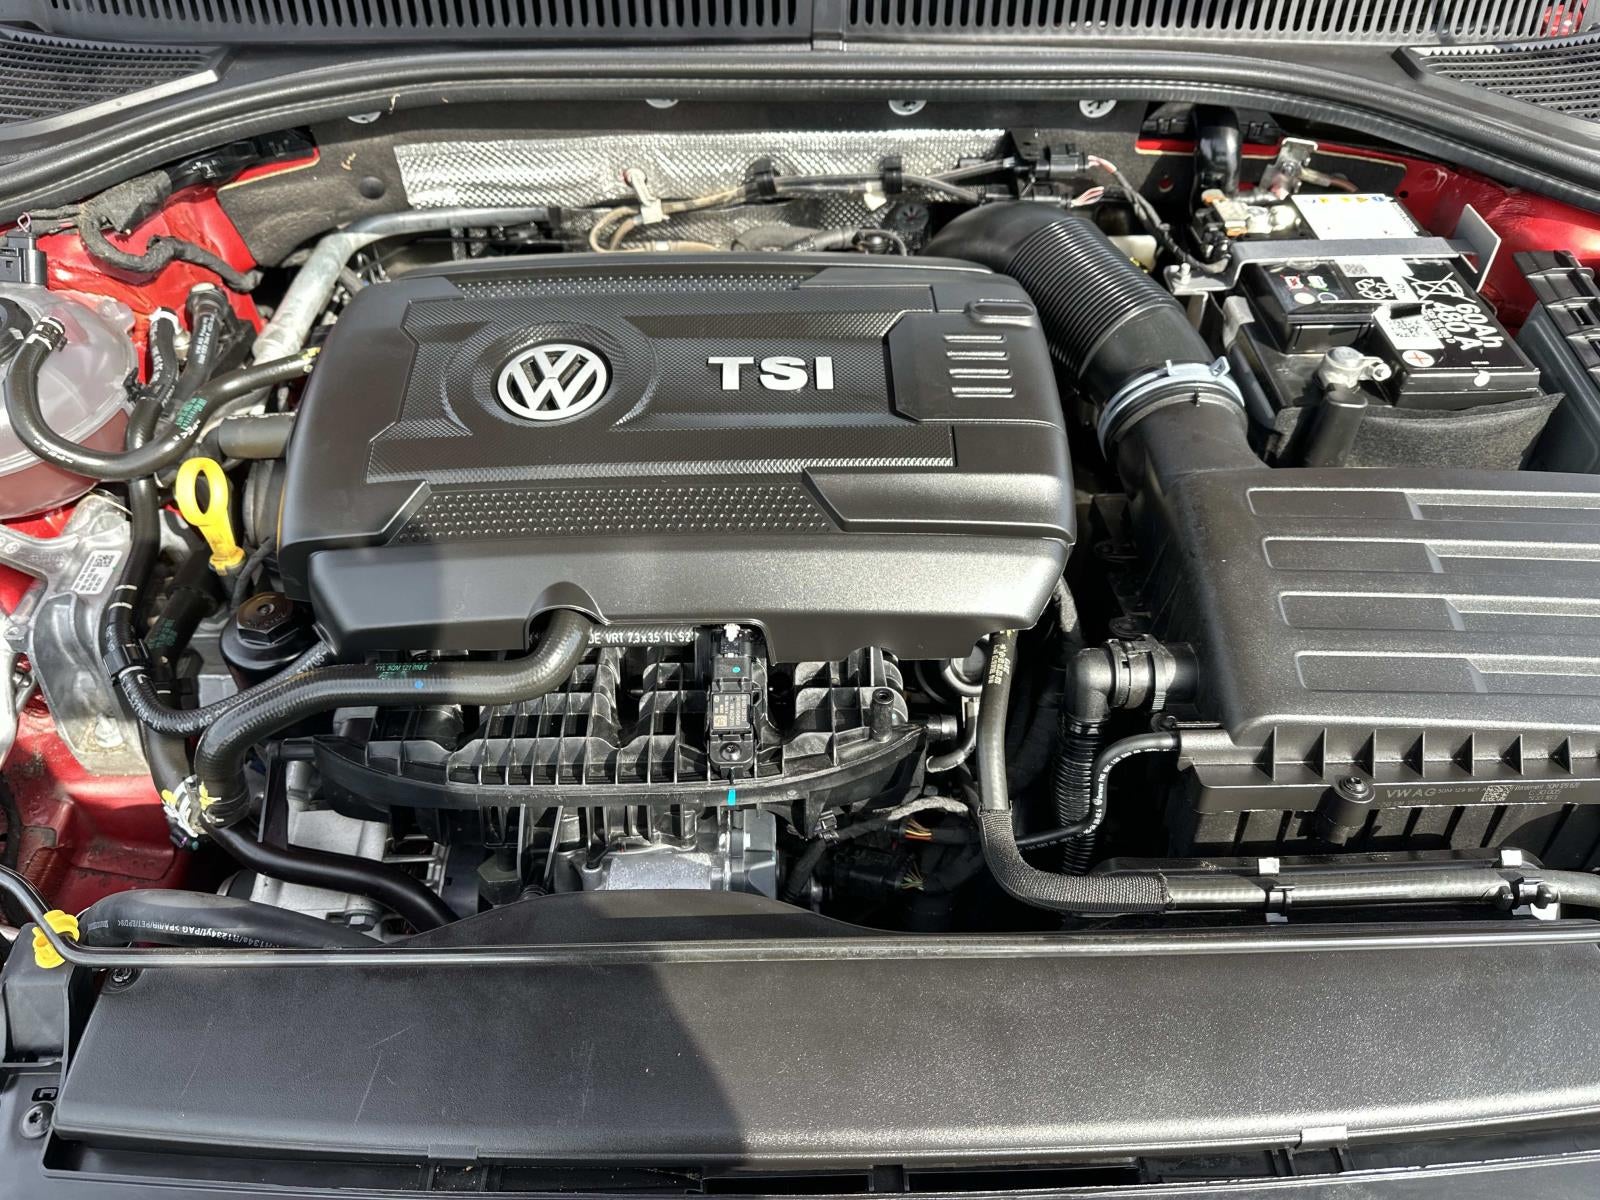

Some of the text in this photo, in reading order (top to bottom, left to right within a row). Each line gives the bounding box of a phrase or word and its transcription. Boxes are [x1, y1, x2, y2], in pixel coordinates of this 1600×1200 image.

[1432, 302, 1471, 333] 480
[1453, 335, 1484, 351] A
[1455, 303, 1504, 348] 60Ah
[708, 356, 835, 392] TSI
[605, 632, 624, 643] VRT
[1386, 788, 1412, 798] VW
[1412, 787, 1437, 798] AG
